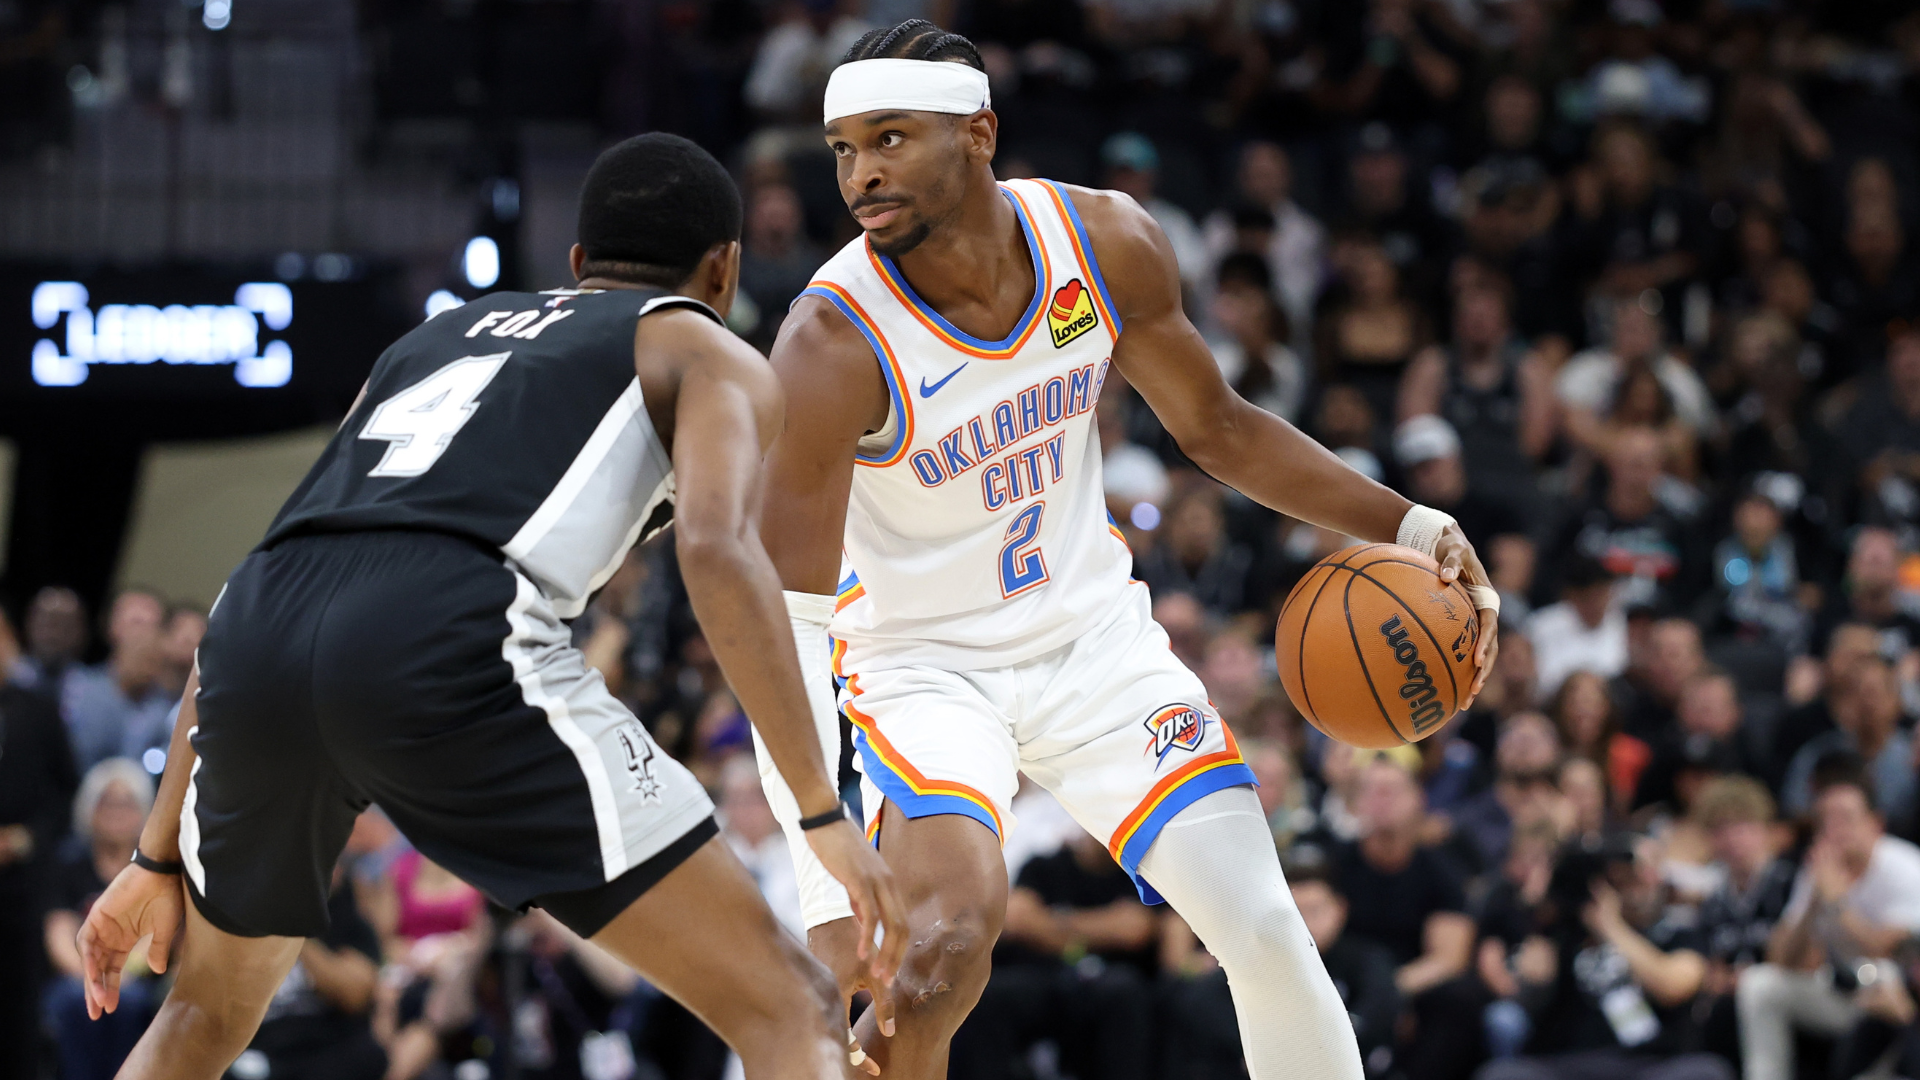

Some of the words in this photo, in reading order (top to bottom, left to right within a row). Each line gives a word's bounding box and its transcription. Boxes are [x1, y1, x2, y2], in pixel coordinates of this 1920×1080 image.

[465, 309, 575, 340] FOX
[357, 351, 513, 477] 4
[981, 429, 1066, 512] CITY
[998, 500, 1050, 600] 2
[1379, 613, 1446, 735] Wilson
[1156, 710, 1196, 757] OKC
